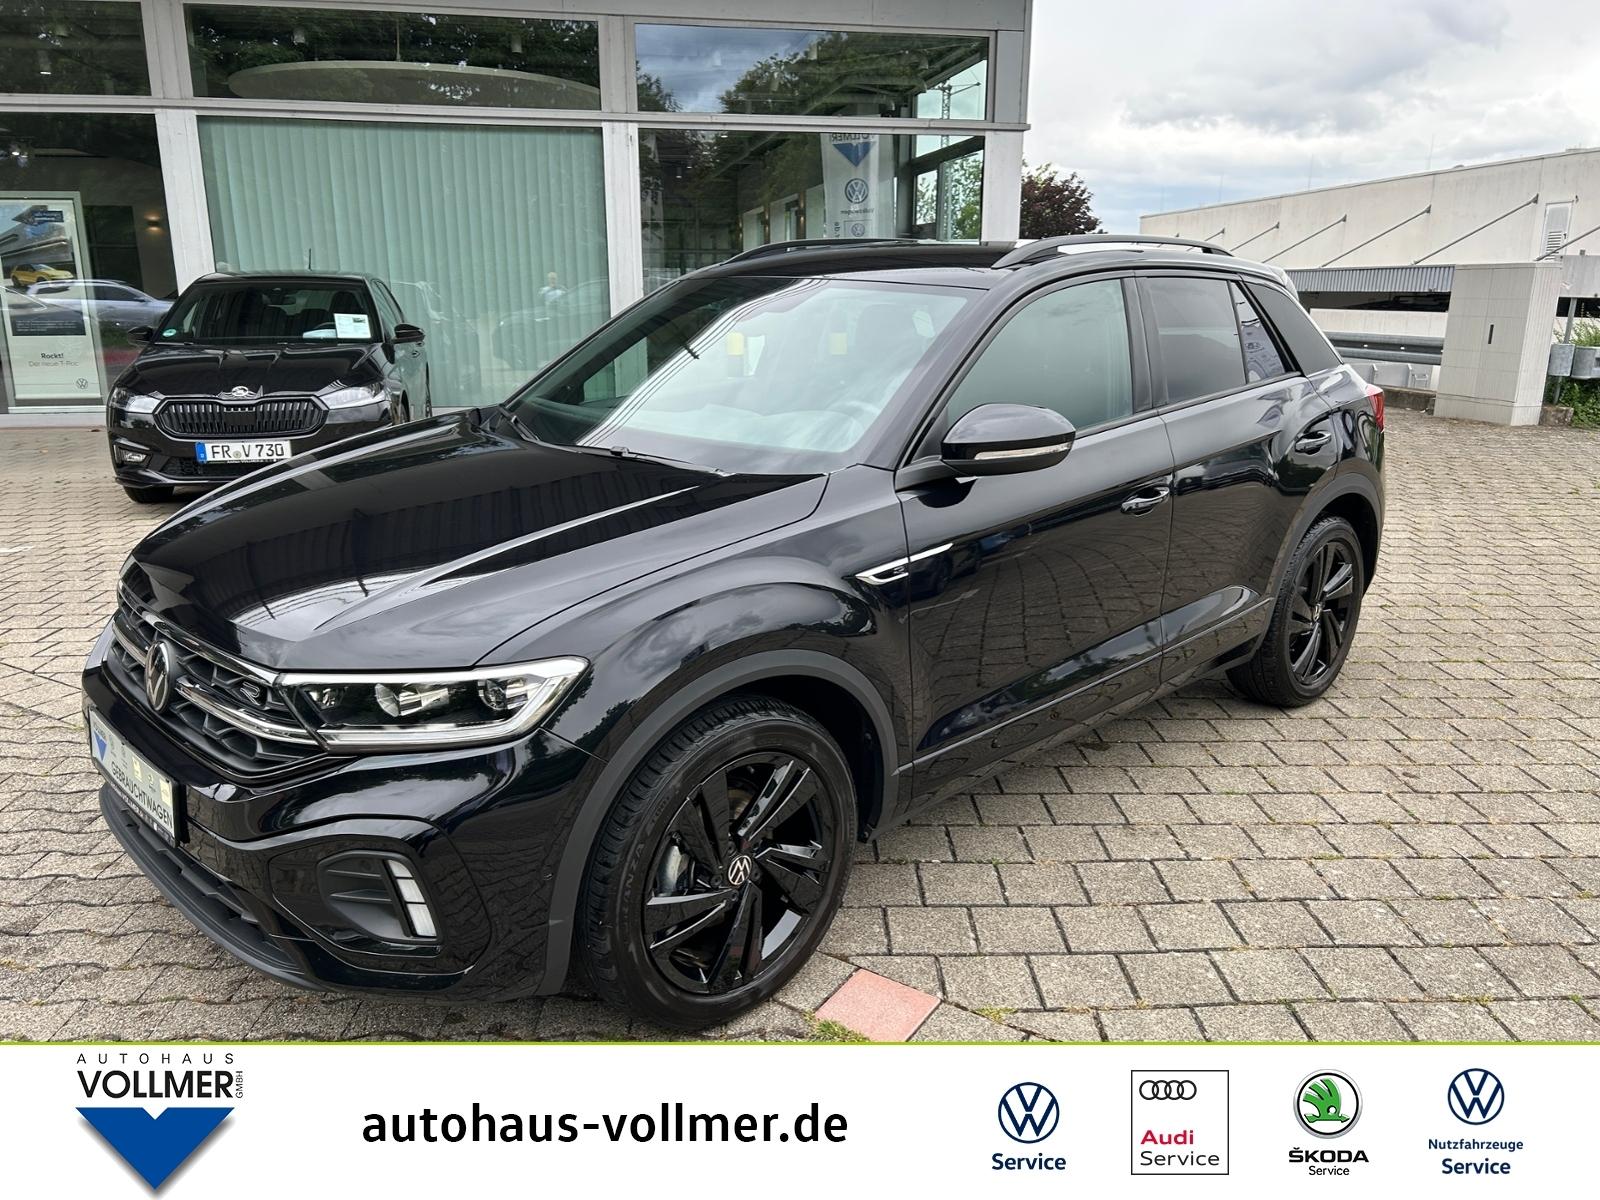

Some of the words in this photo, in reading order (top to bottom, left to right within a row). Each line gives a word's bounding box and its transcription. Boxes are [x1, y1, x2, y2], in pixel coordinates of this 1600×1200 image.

[211, 445, 232, 459] FR
[242, 444, 251, 458] V
[255, 443, 285, 458] 730
[111, 761, 173, 829] GEBRAUCHTWAGEN
